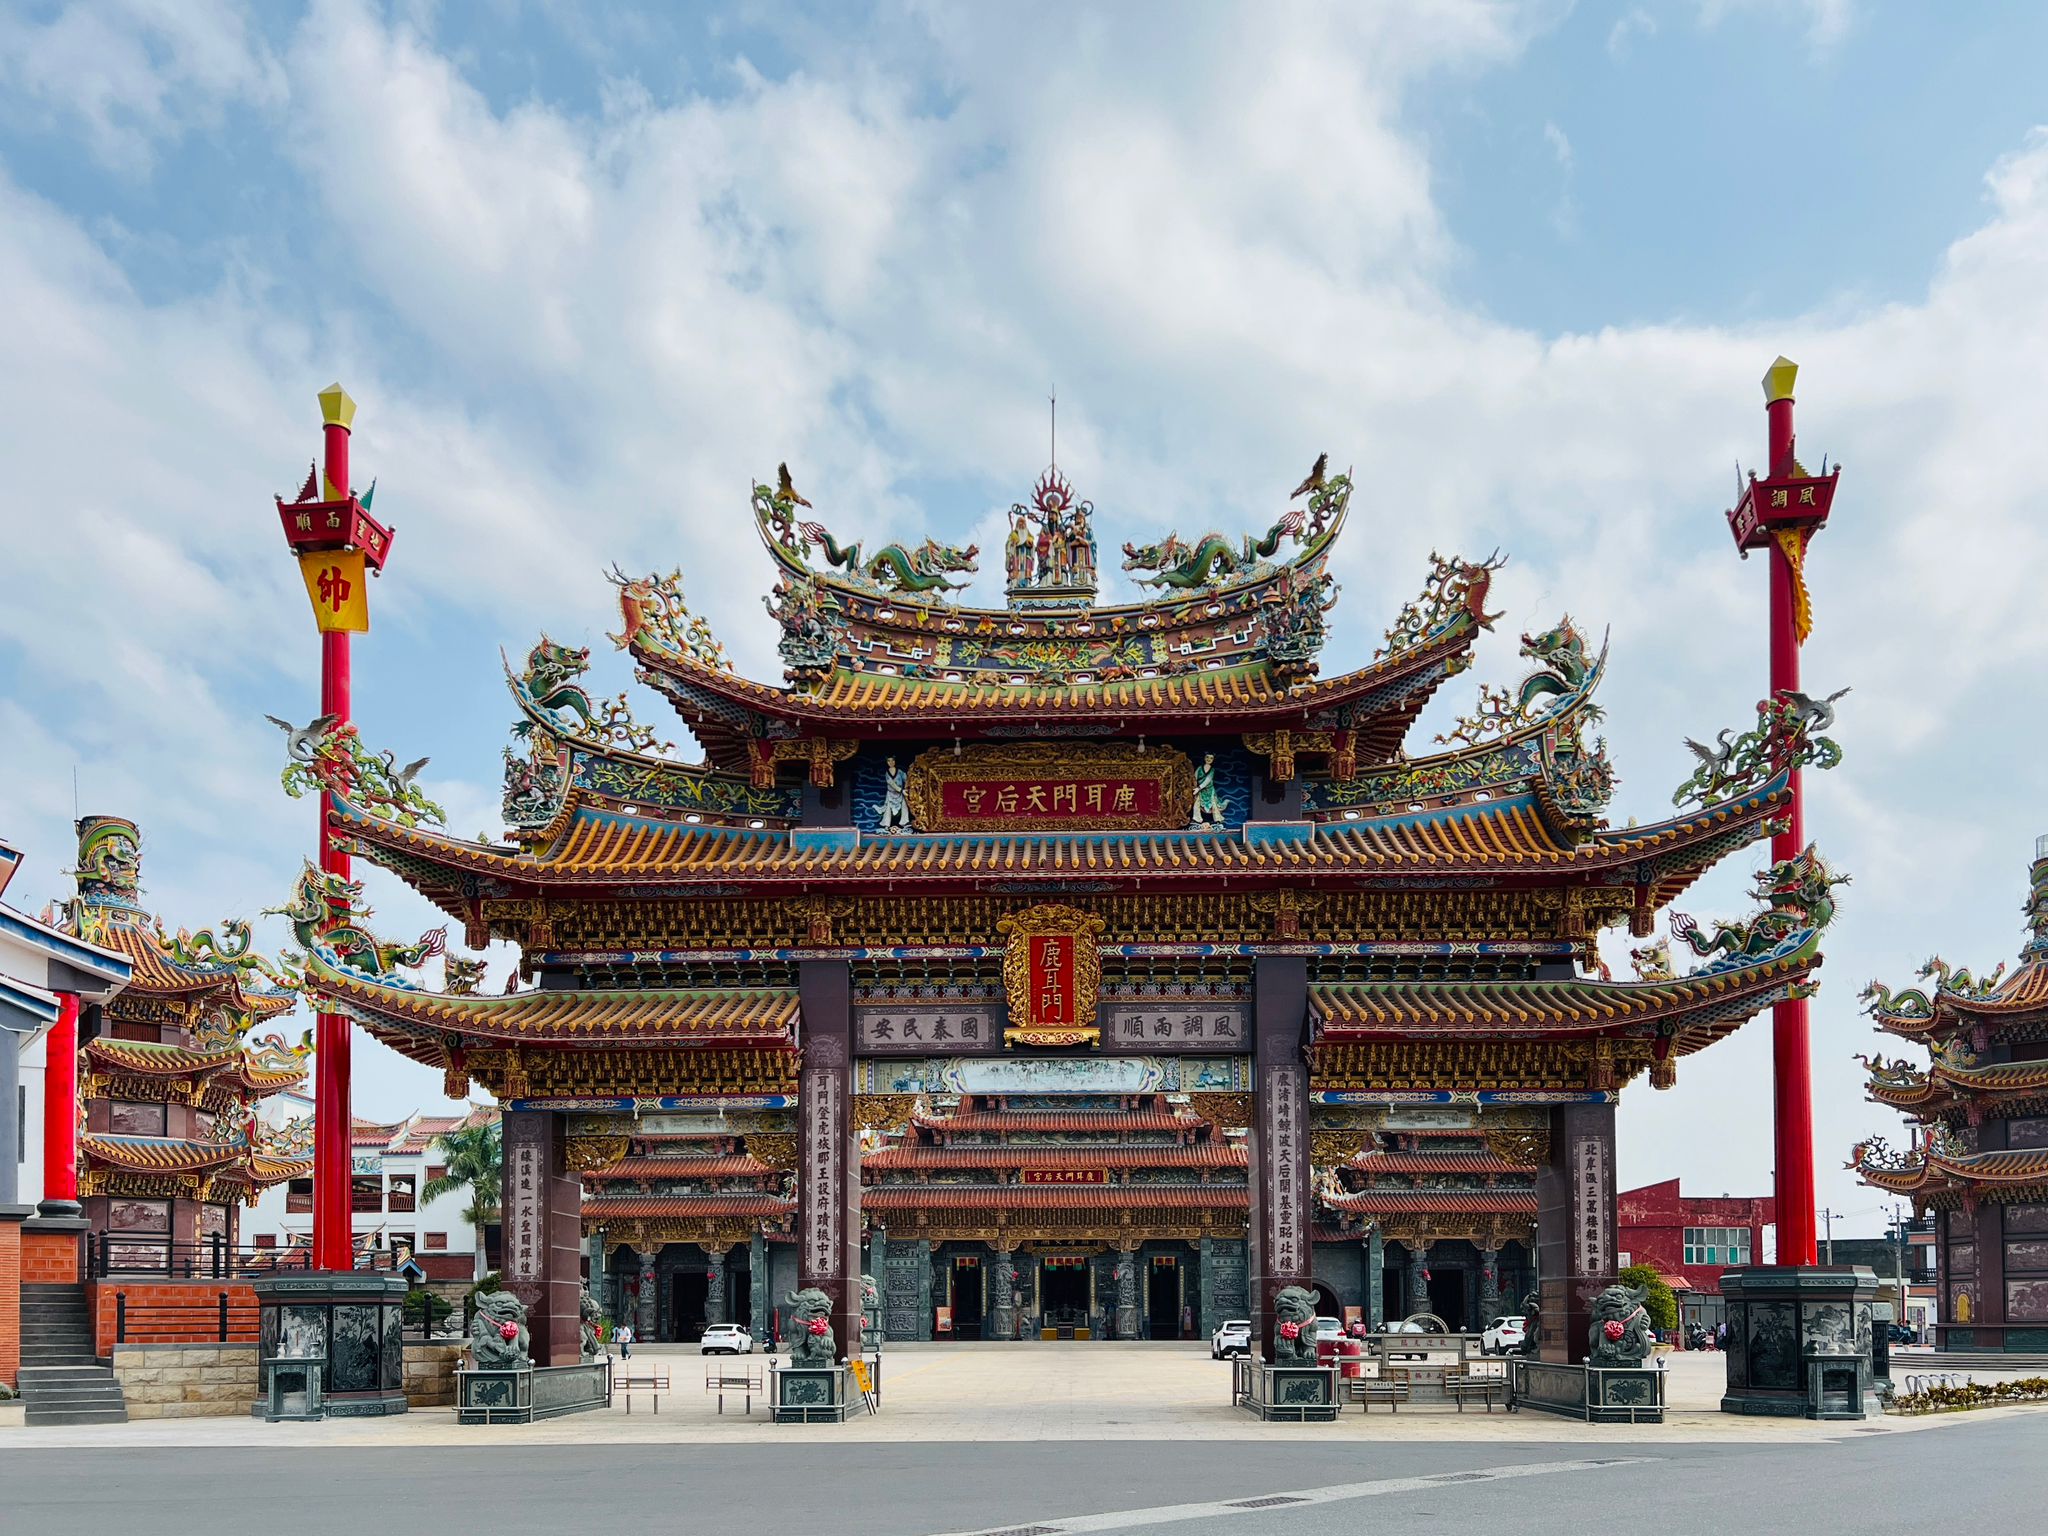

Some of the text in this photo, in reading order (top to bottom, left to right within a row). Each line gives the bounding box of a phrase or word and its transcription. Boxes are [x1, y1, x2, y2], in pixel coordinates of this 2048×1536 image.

[317, 566, 352, 613] 帥
[1039, 938, 1063, 1020] 鹿耳門
